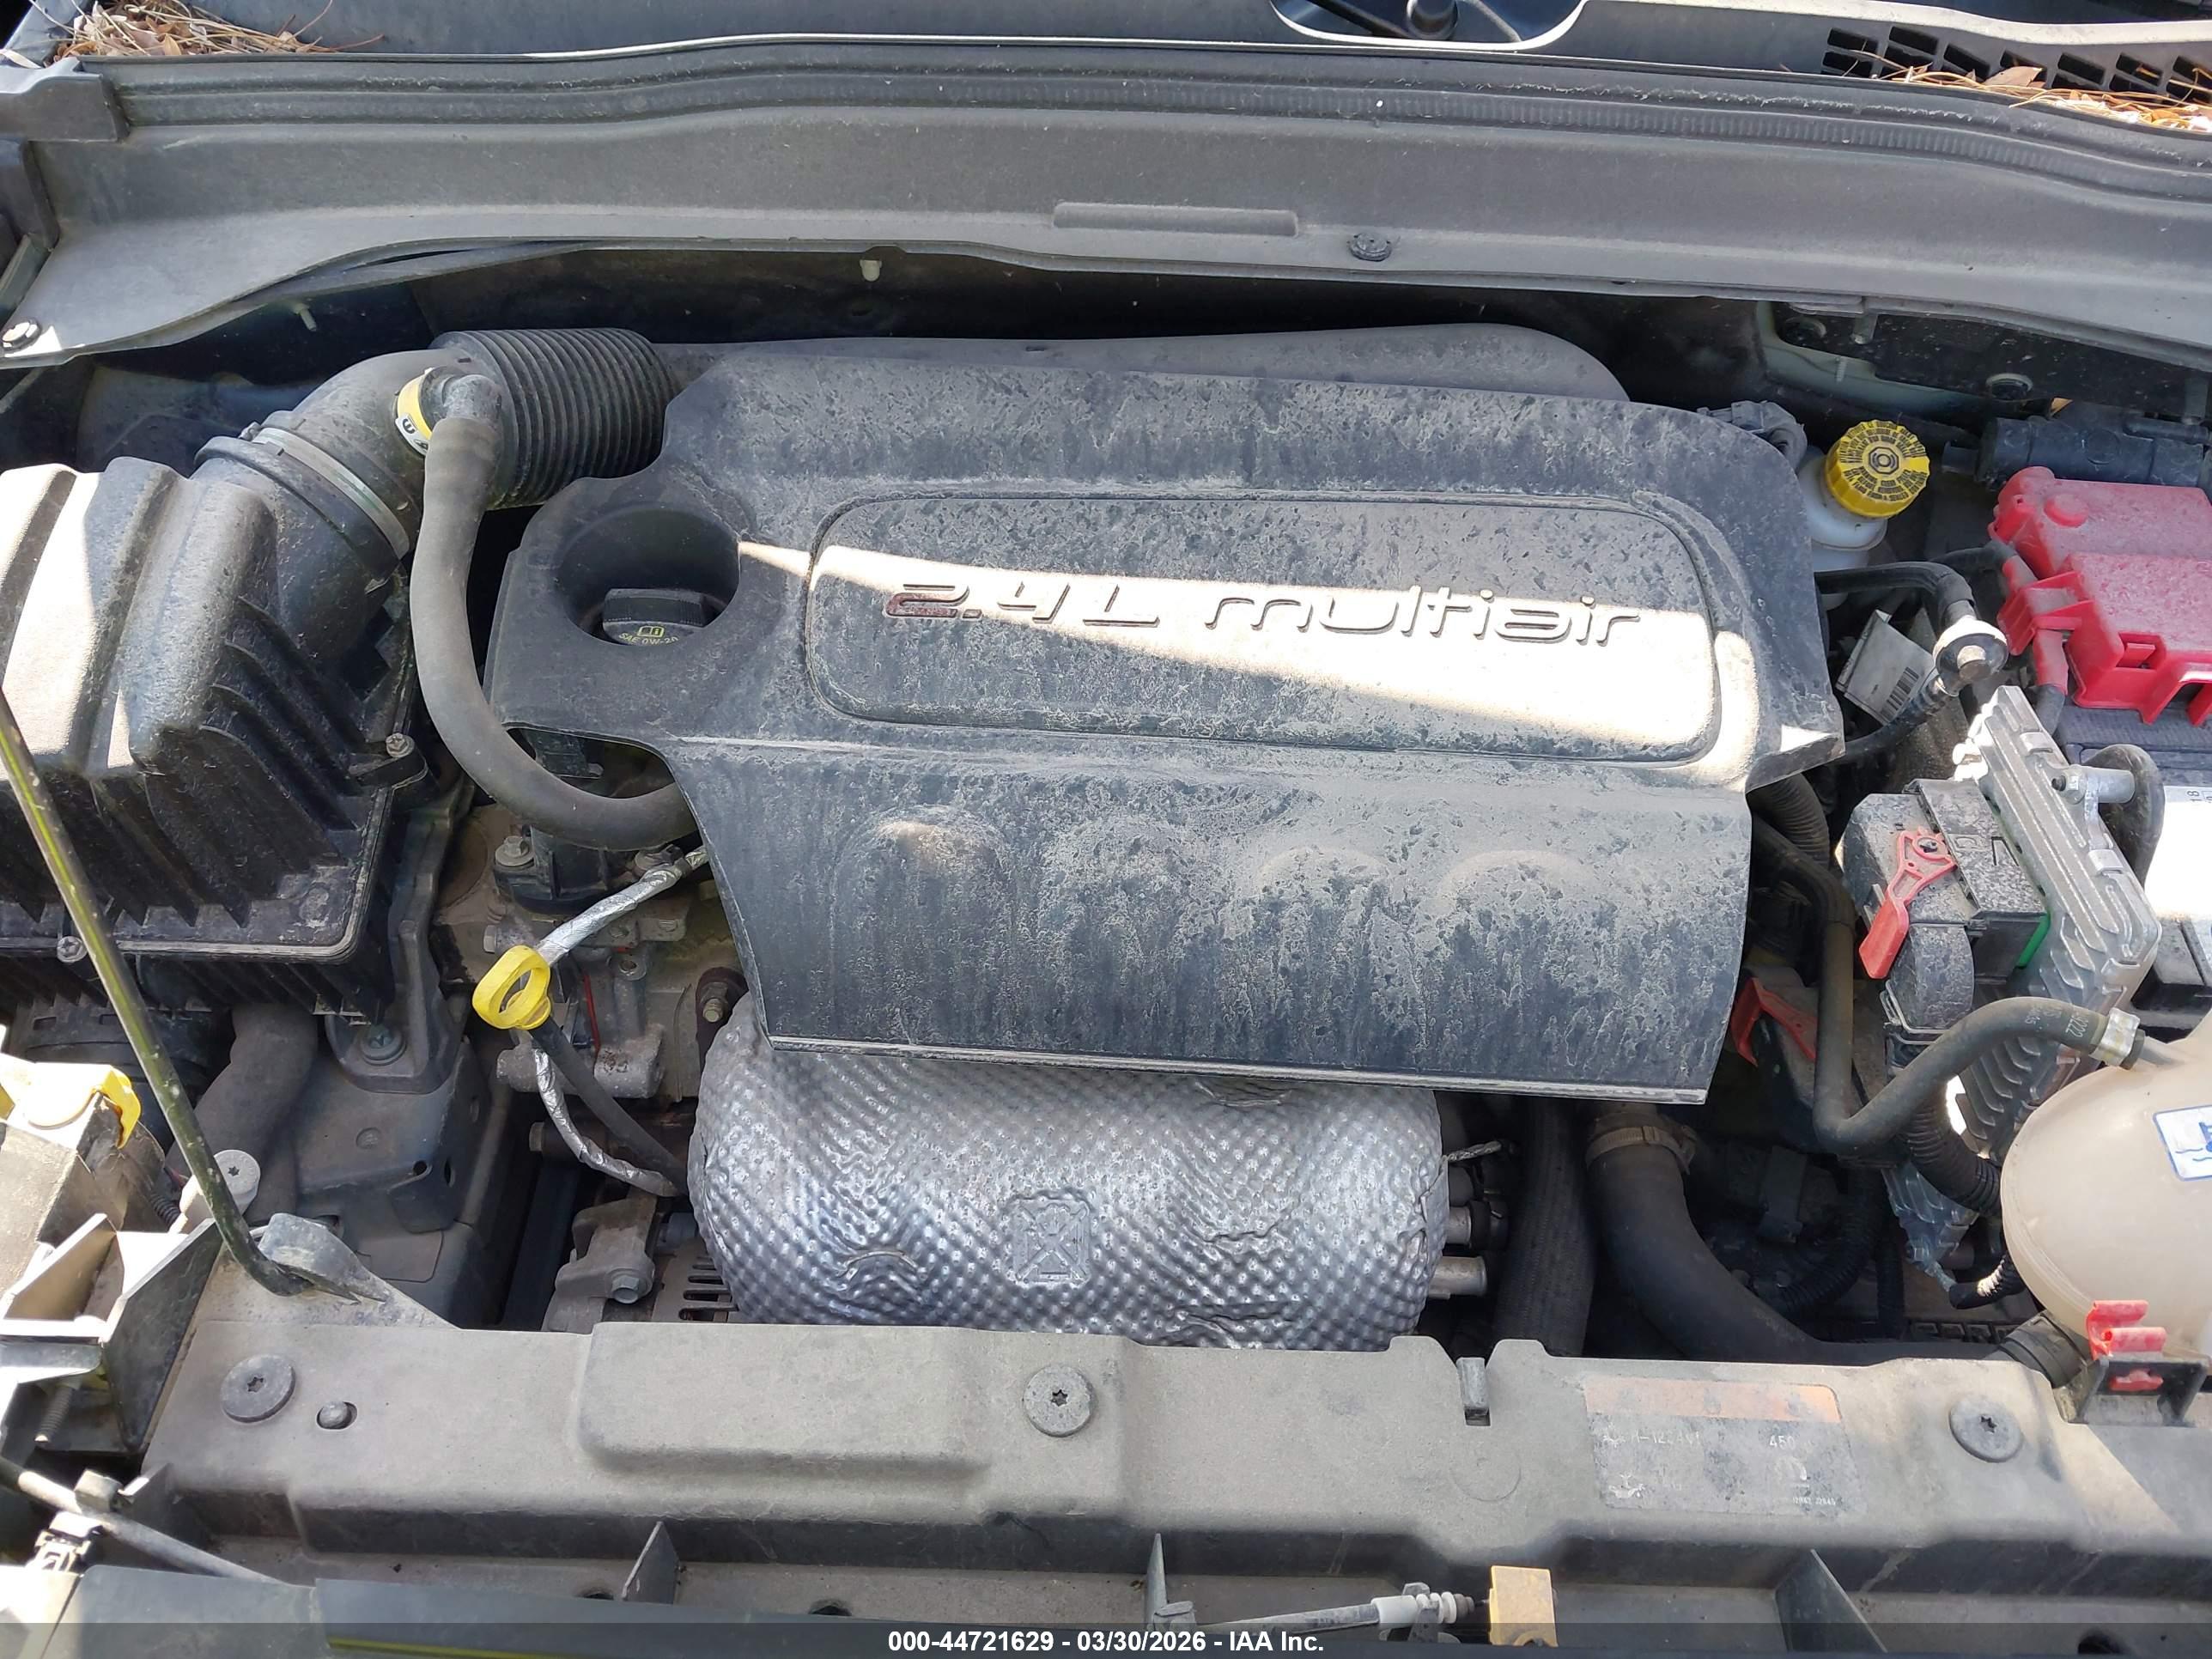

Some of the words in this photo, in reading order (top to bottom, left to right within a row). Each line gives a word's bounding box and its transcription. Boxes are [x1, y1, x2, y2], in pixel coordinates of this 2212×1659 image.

[885, 580, 1160, 629] 2.4L
[1204, 585, 1641, 647] multiair
[618, 632, 641, 644] SAE
